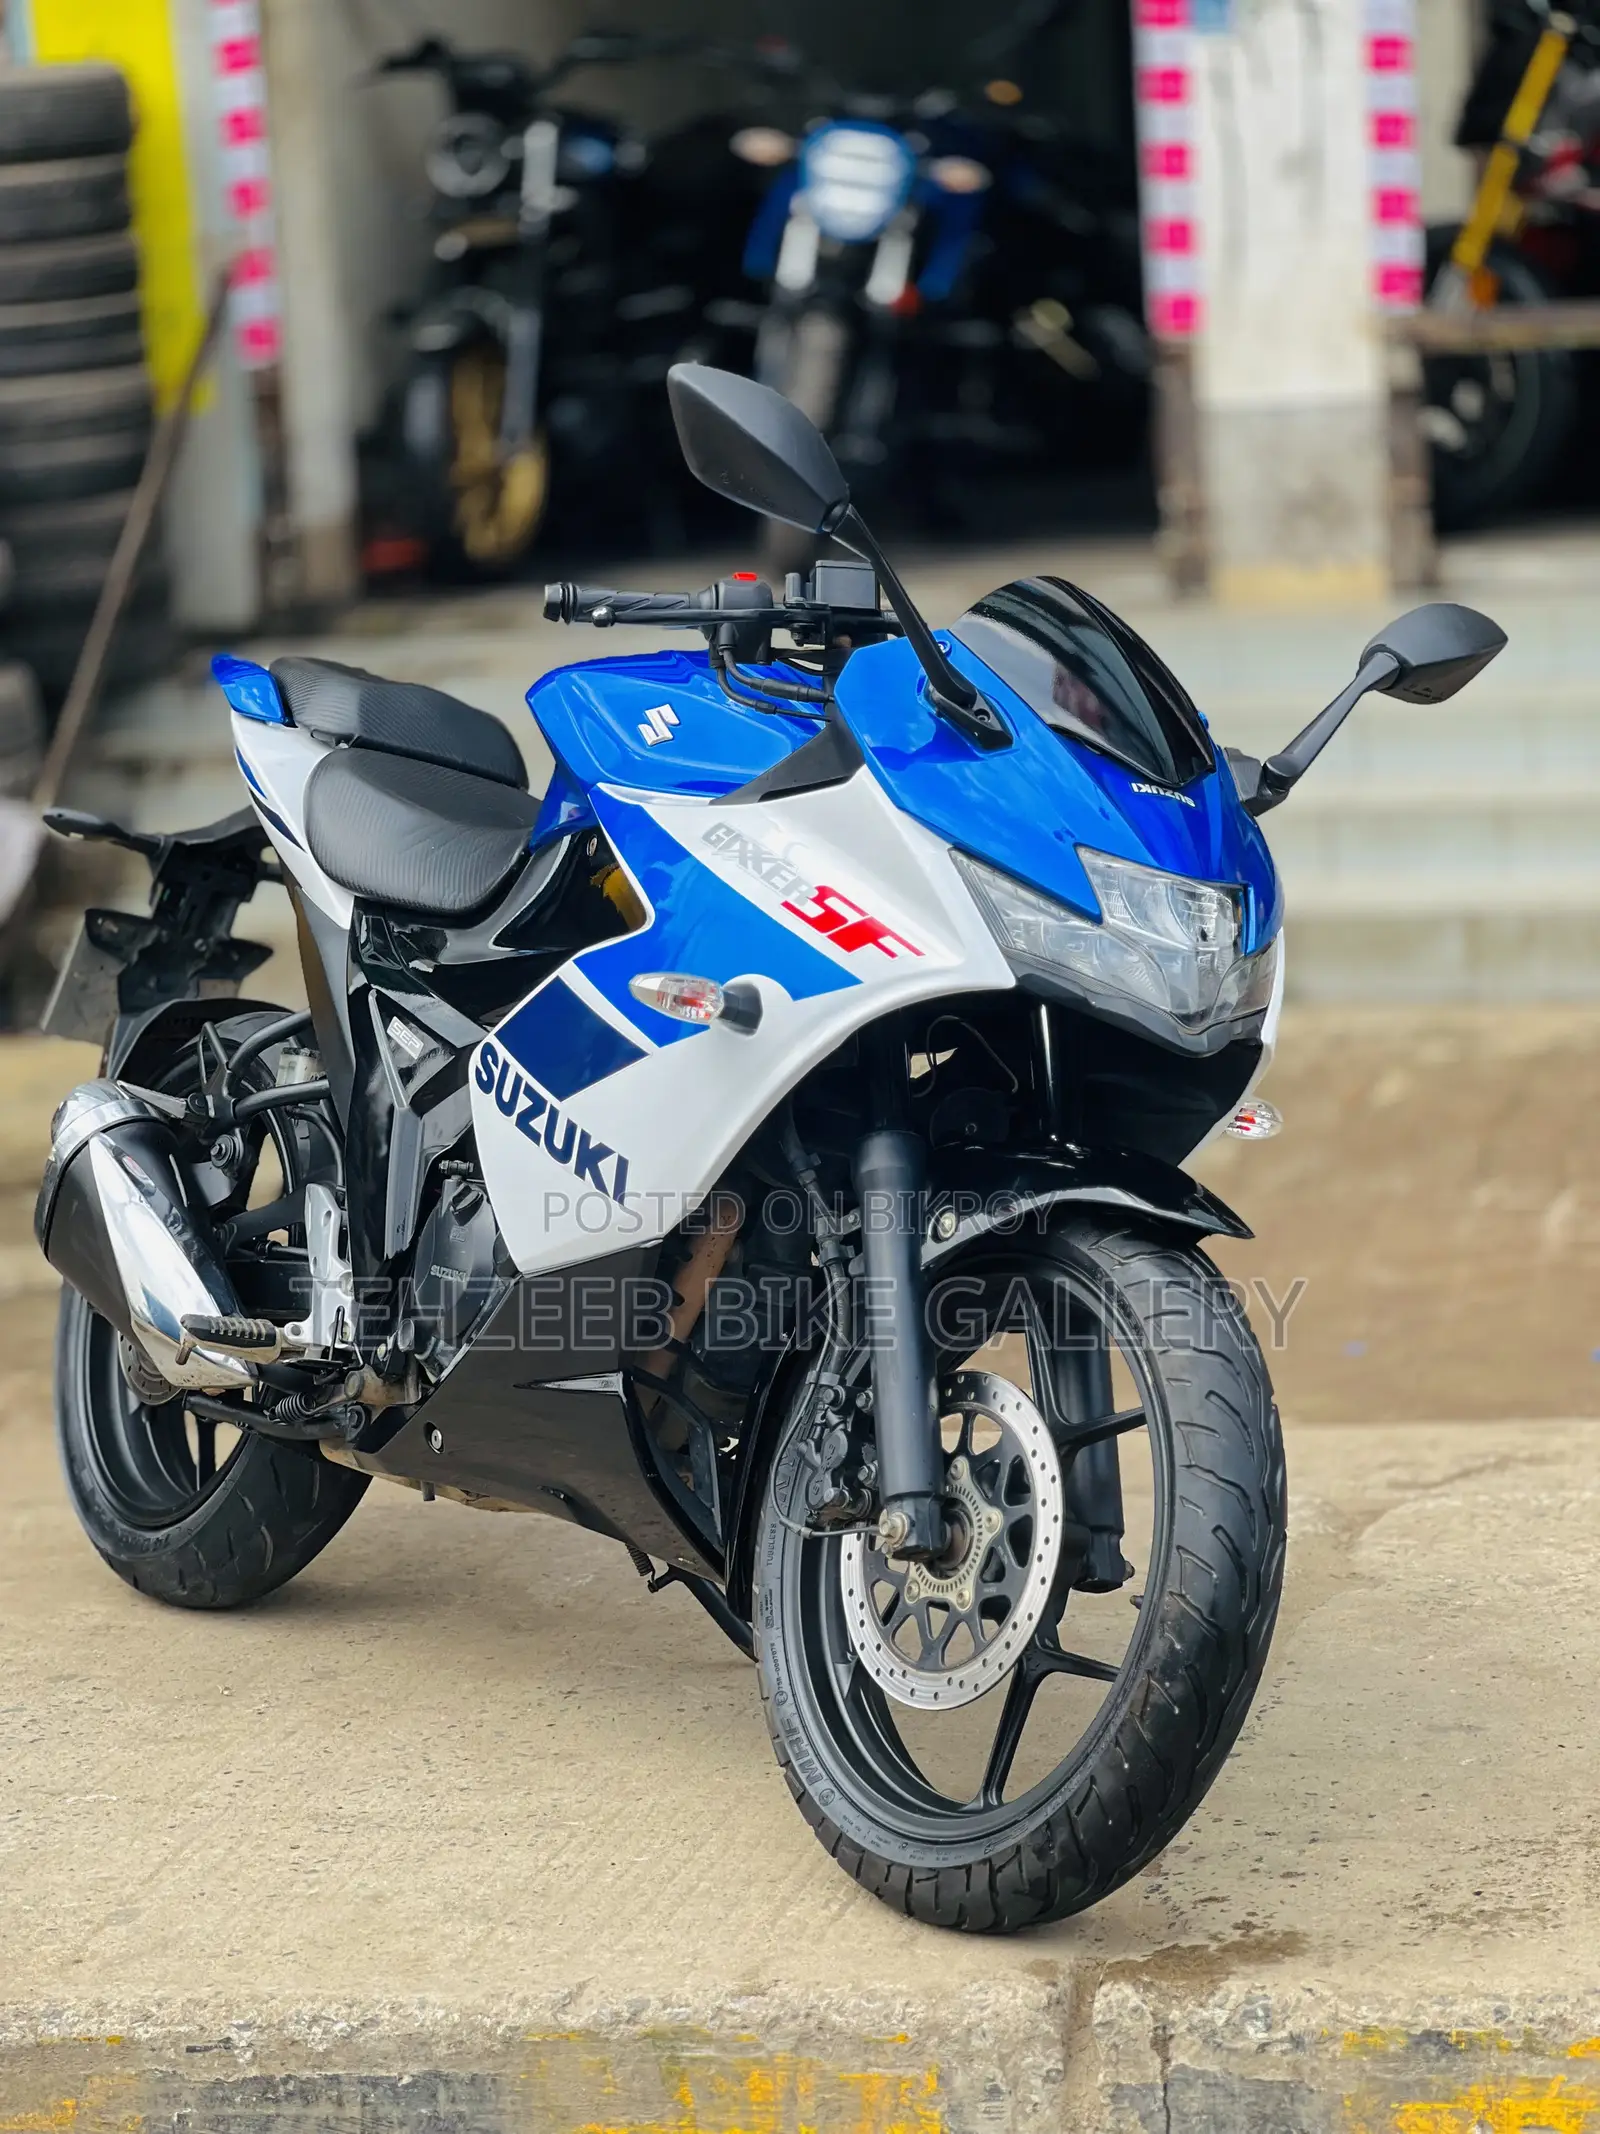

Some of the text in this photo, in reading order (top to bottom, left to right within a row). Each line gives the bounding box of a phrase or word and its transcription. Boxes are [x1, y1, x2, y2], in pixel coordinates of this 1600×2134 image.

[1131, 782, 1196, 808] SUZUKI
[701, 821, 927, 959] GIXXER SF
[390, 1020, 421, 1049] SEP
[475, 1041, 630, 1207] SUZUKI
[430, 1264, 467, 1283] SUZUKI
[780, 1718, 824, 1786] MRF
